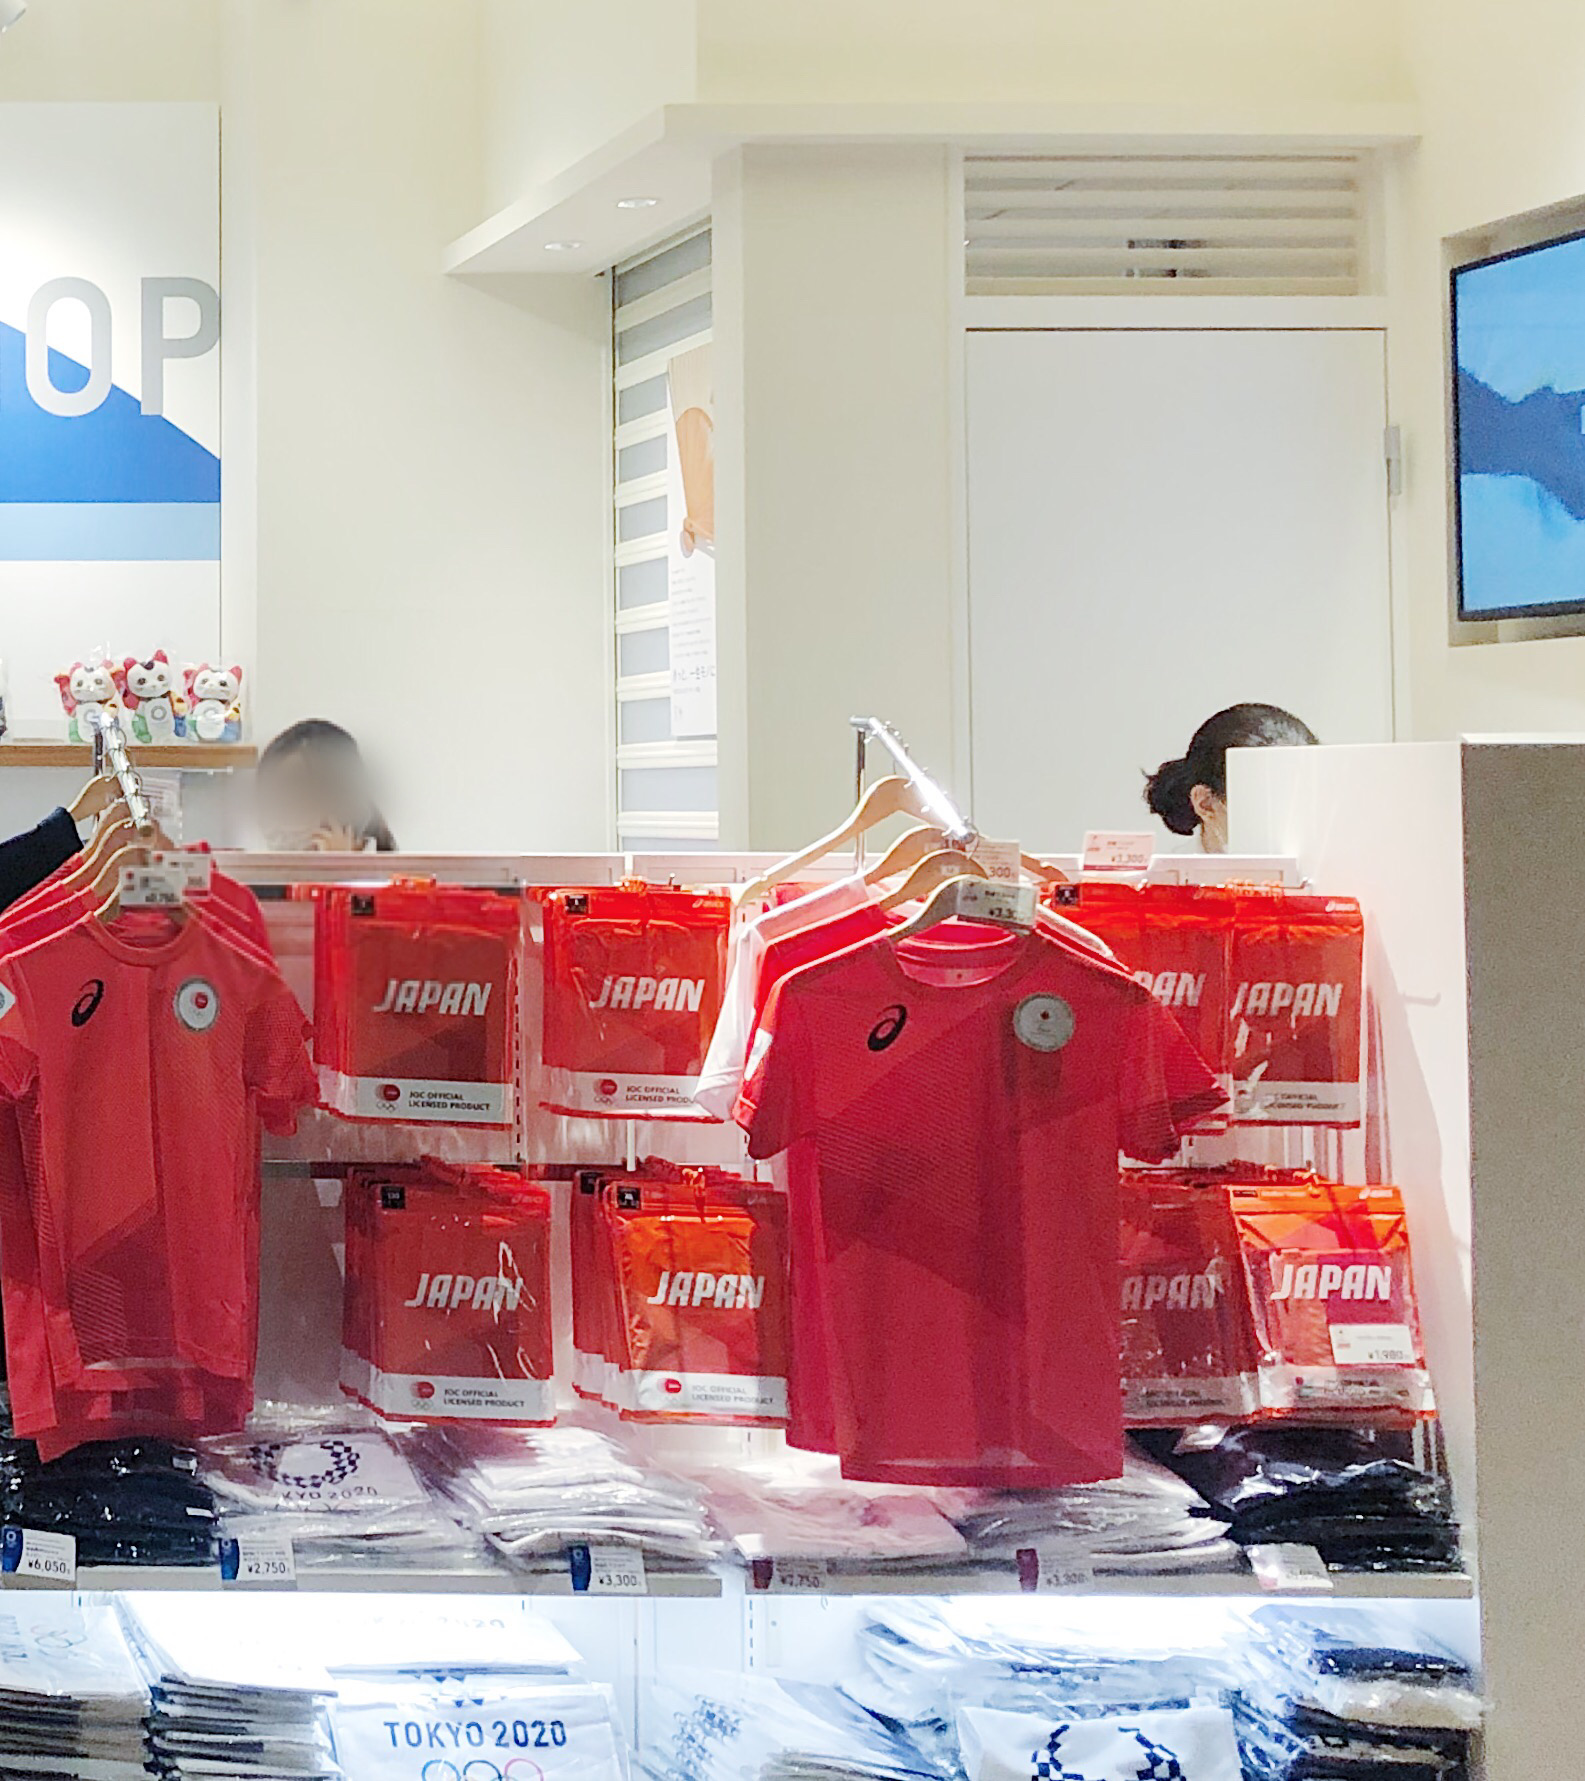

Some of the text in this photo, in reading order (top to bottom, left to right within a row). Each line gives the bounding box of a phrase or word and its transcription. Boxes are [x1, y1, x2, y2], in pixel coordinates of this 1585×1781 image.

[589, 975, 705, 1012] JAPAN
[1134, 970, 1207, 1007] PAN
[373, 978, 493, 1016] JAPAN
[1230, 982, 1343, 1018] JAPAN
[428, 1091, 464, 1101] OFFICIAL
[644, 1086, 680, 1095] OFFICIAL
[409, 1100, 491, 1111] LICENSED PRODUCT
[626, 1094, 664, 1104] LICENSED
[1270, 1263, 1392, 1301] JAPAN
[404, 1273, 524, 1311] JAPAN
[647, 1271, 765, 1309] JAPAN
[1120, 1274, 1217, 1311] APAN
[462, 1389, 499, 1398] OFFICIAL
[444, 1398, 525, 1408] LICENSED PRODUCT
[328, 1486, 378, 1499] 2020
[28, 1560, 67, 1575] ¥6,050
[247, 1562, 287, 1574] ¥2,750
[599, 1575, 639, 1587] ¥3,300
[383, 1719, 567, 1749] TOKYO 2020
